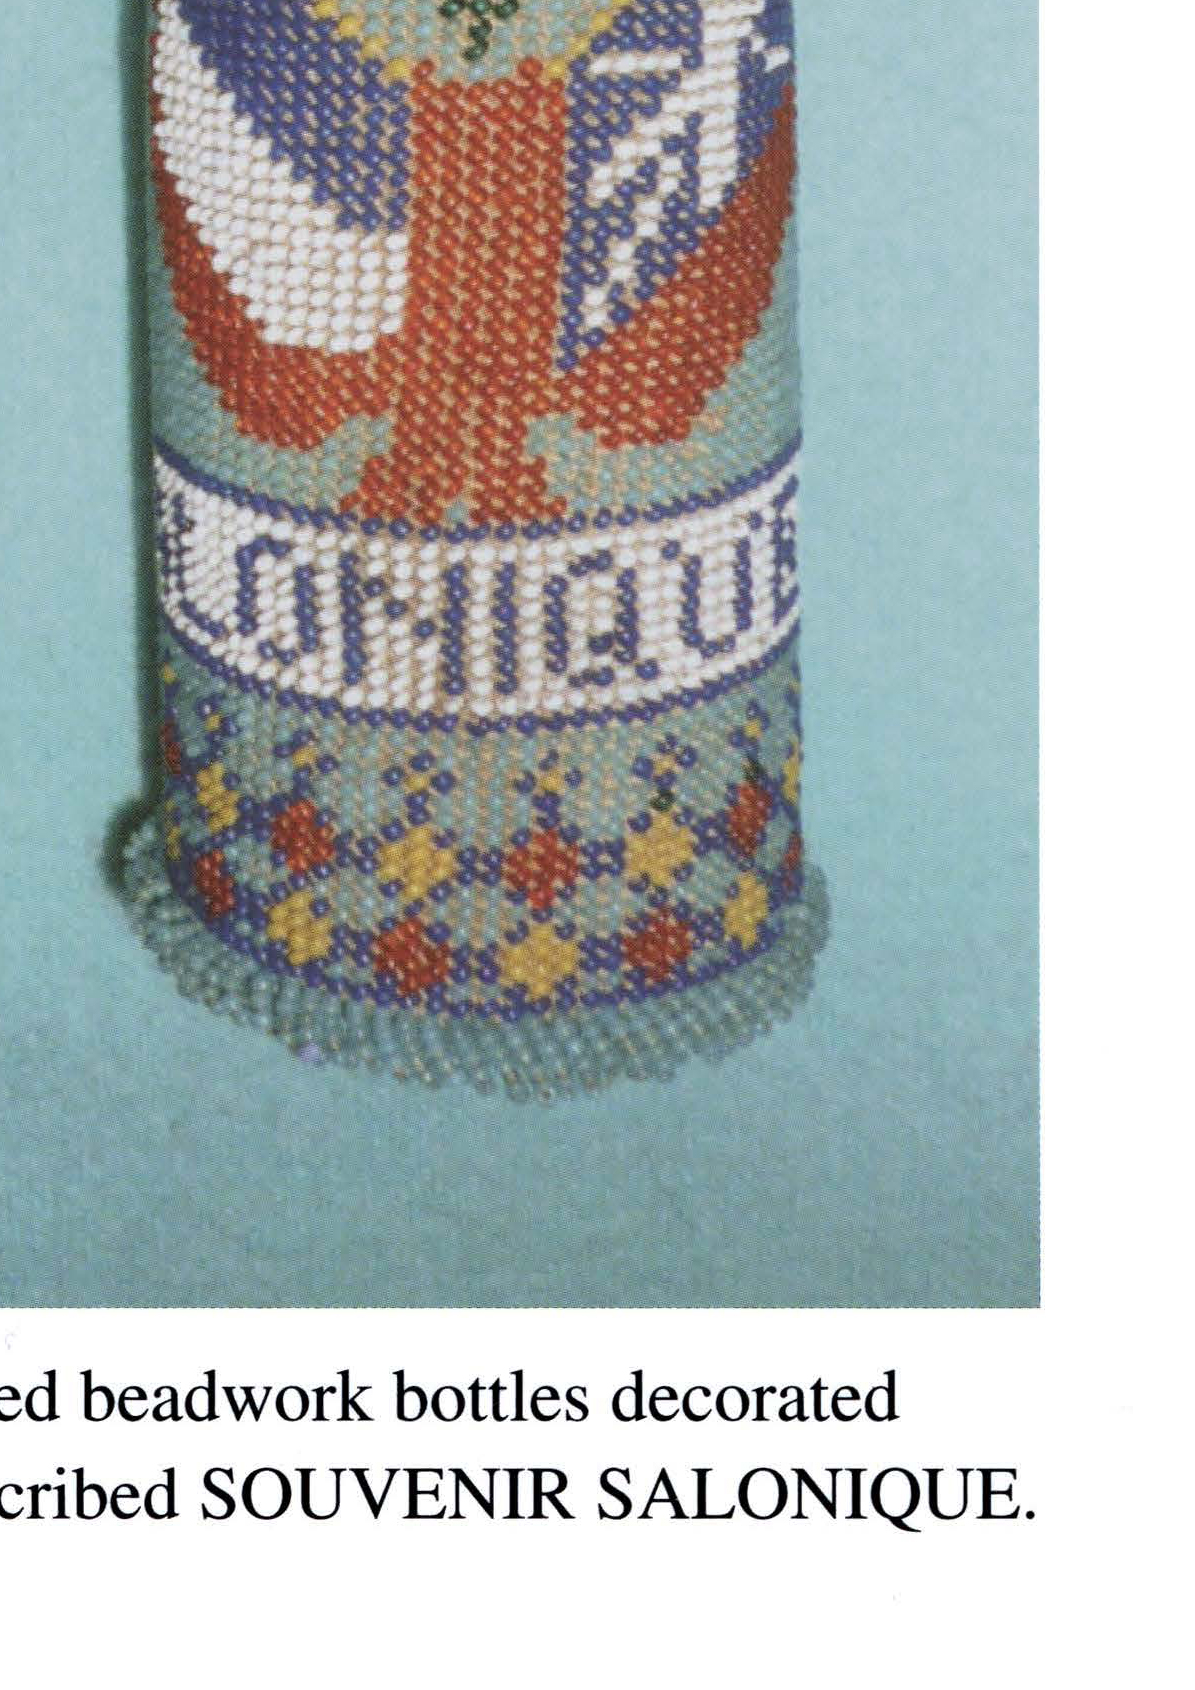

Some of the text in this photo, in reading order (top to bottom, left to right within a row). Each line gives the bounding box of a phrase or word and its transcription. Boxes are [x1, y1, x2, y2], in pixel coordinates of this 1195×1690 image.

[80, 1370, 374, 1422] beadwork
[393, 1370, 589, 1422] bottles
[612, 1370, 900, 1422] decorated
[202, 1468, 575, 1520] SOUVENIR
[598, 1467, 1035, 1532] SALONIQUE.
